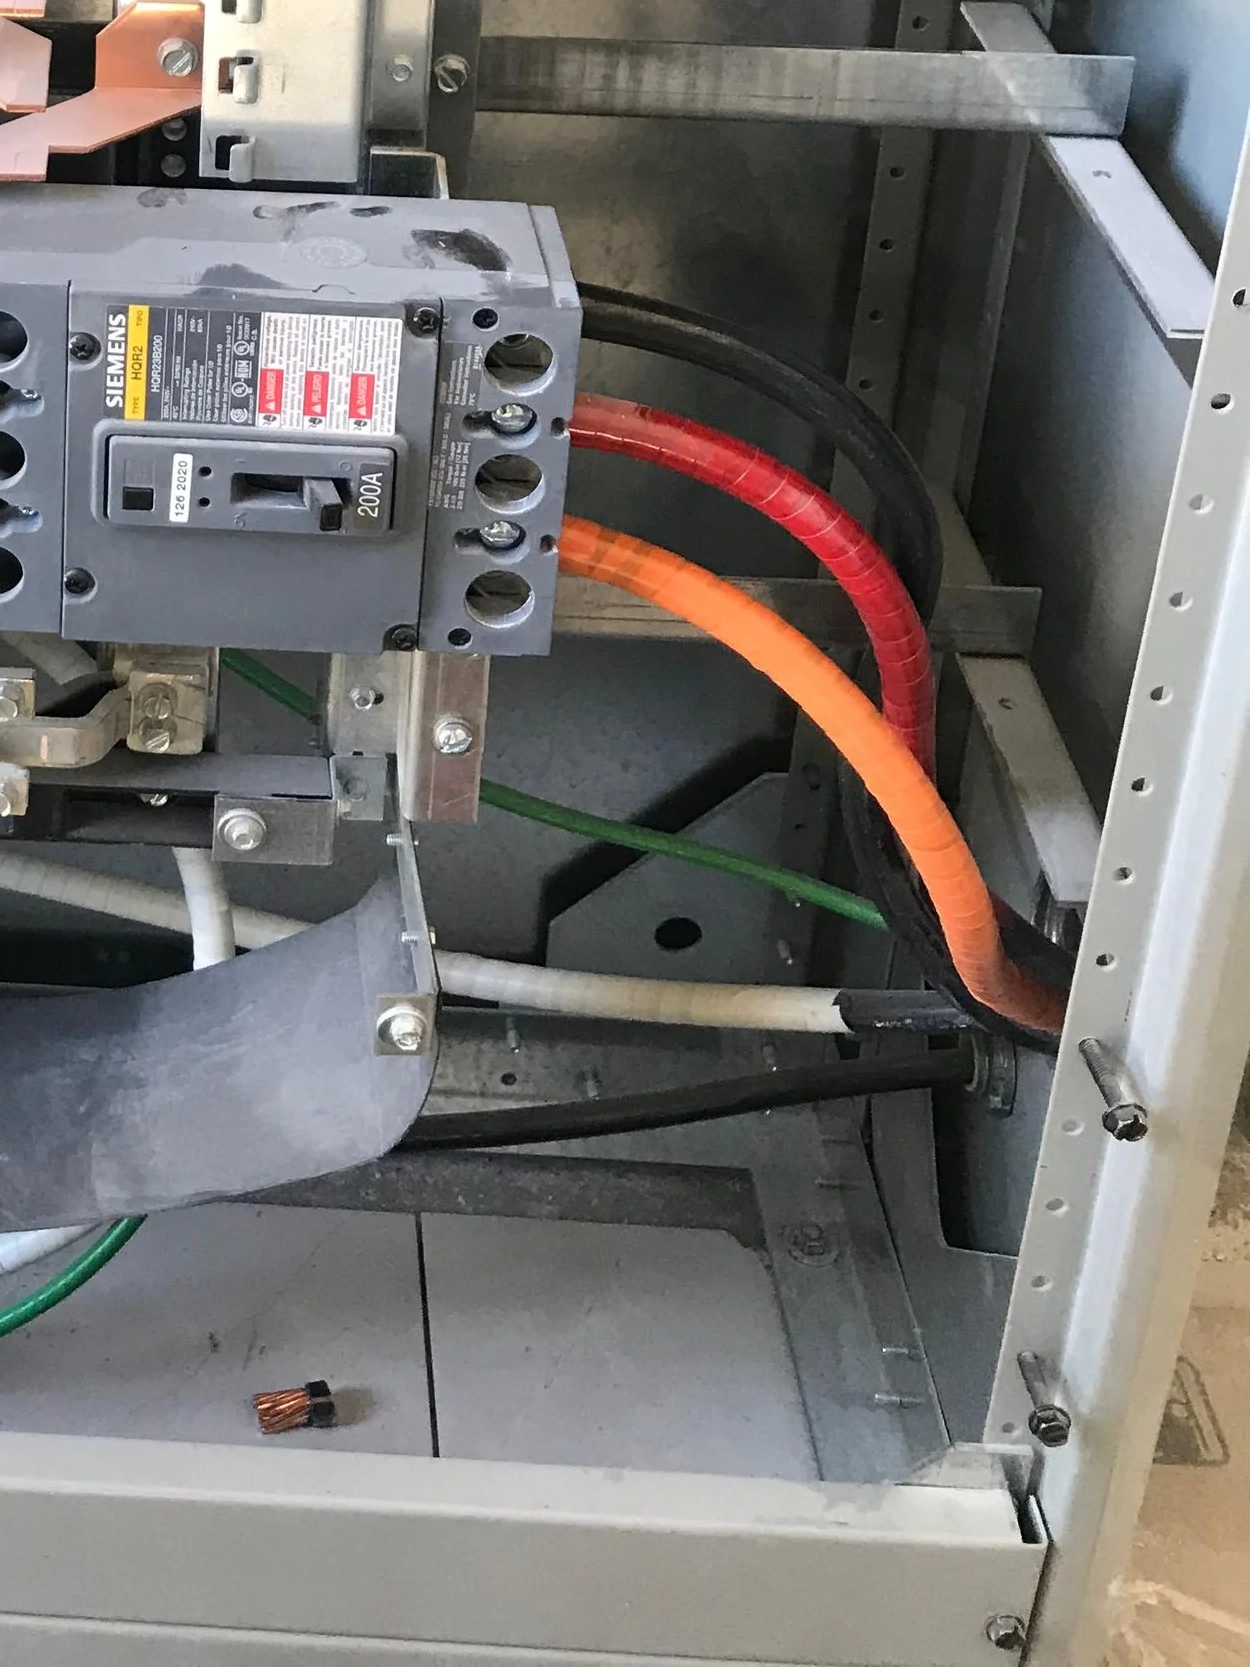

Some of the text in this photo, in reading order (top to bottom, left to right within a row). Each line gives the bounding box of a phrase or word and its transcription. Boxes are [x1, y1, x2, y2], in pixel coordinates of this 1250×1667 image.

[106, 313, 126, 408] SIEMENS
[131, 345, 144, 381] HQR2
[150, 334, 163, 393] HQR23B200
[266, 370, 276, 400] DANGER
[312, 374, 323, 402] PELIGRO
[357, 376, 367, 406] DANGER
[175, 460, 188, 517] 126 2020
[358, 472, 383, 518] 200A
